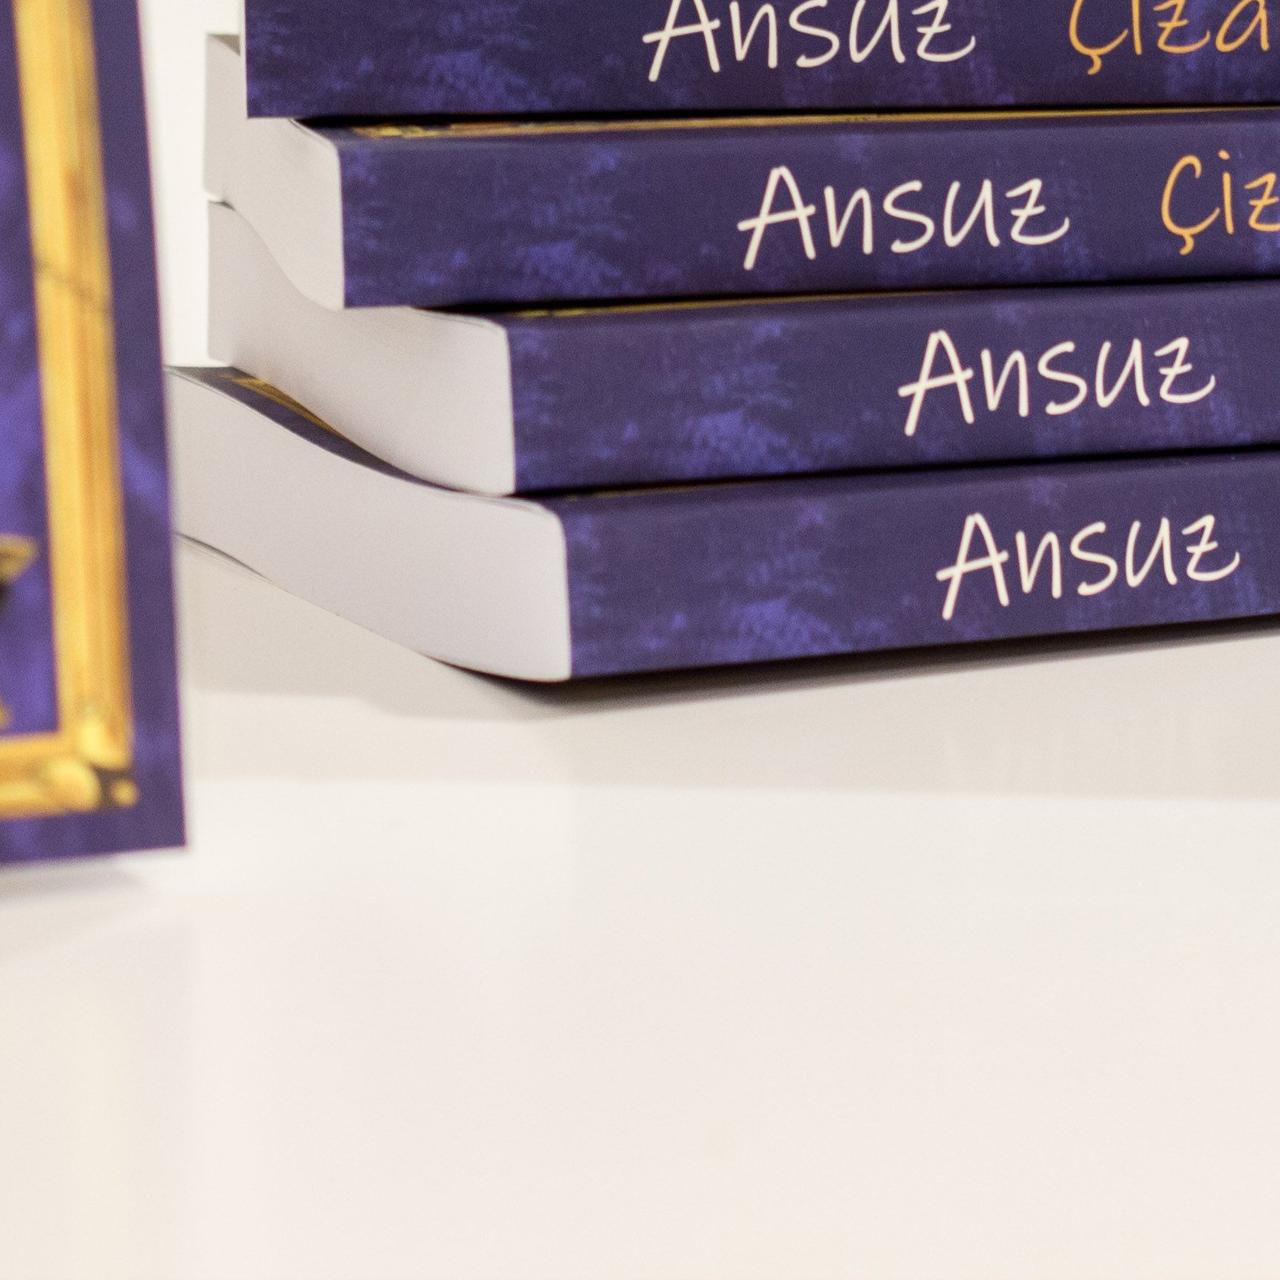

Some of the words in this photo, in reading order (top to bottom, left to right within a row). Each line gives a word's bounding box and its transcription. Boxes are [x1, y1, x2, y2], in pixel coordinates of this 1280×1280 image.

[735, 164, 1071, 272] Ansuz
[896, 328, 1217, 438] Ansuz
[934, 511, 1242, 622] Ansuz
